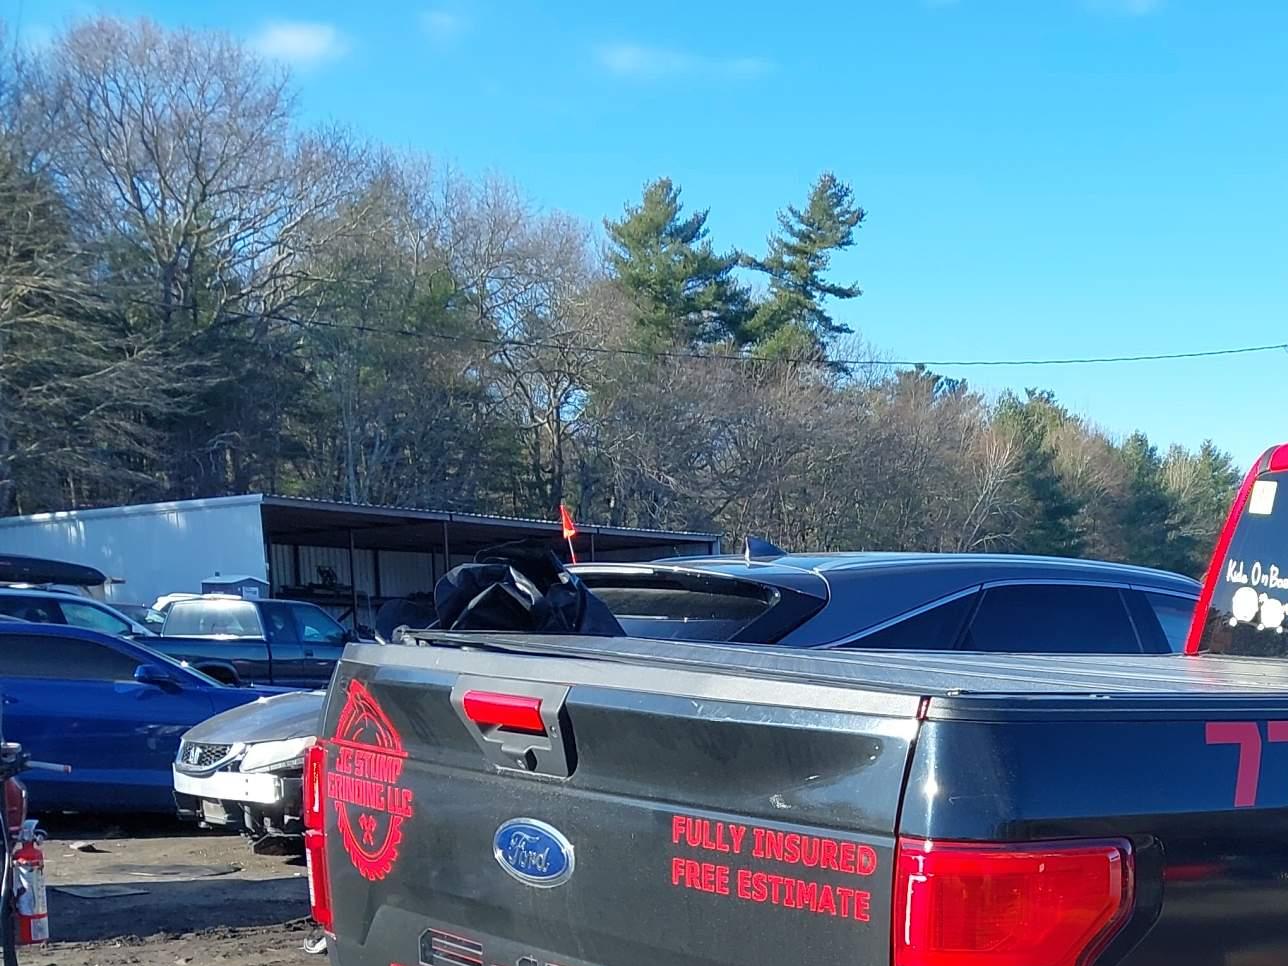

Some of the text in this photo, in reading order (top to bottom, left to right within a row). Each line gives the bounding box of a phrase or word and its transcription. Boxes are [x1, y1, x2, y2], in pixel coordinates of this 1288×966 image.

[1251, 561, 1268, 587] On
[336, 746, 403, 784] JC STUMP
[327, 772, 412, 817] GRINDING LLC
[508, 830, 551, 873] Ford
[672, 815, 877, 876] FULLY INSURED
[671, 857, 870, 922] FREE ESTIMATE
